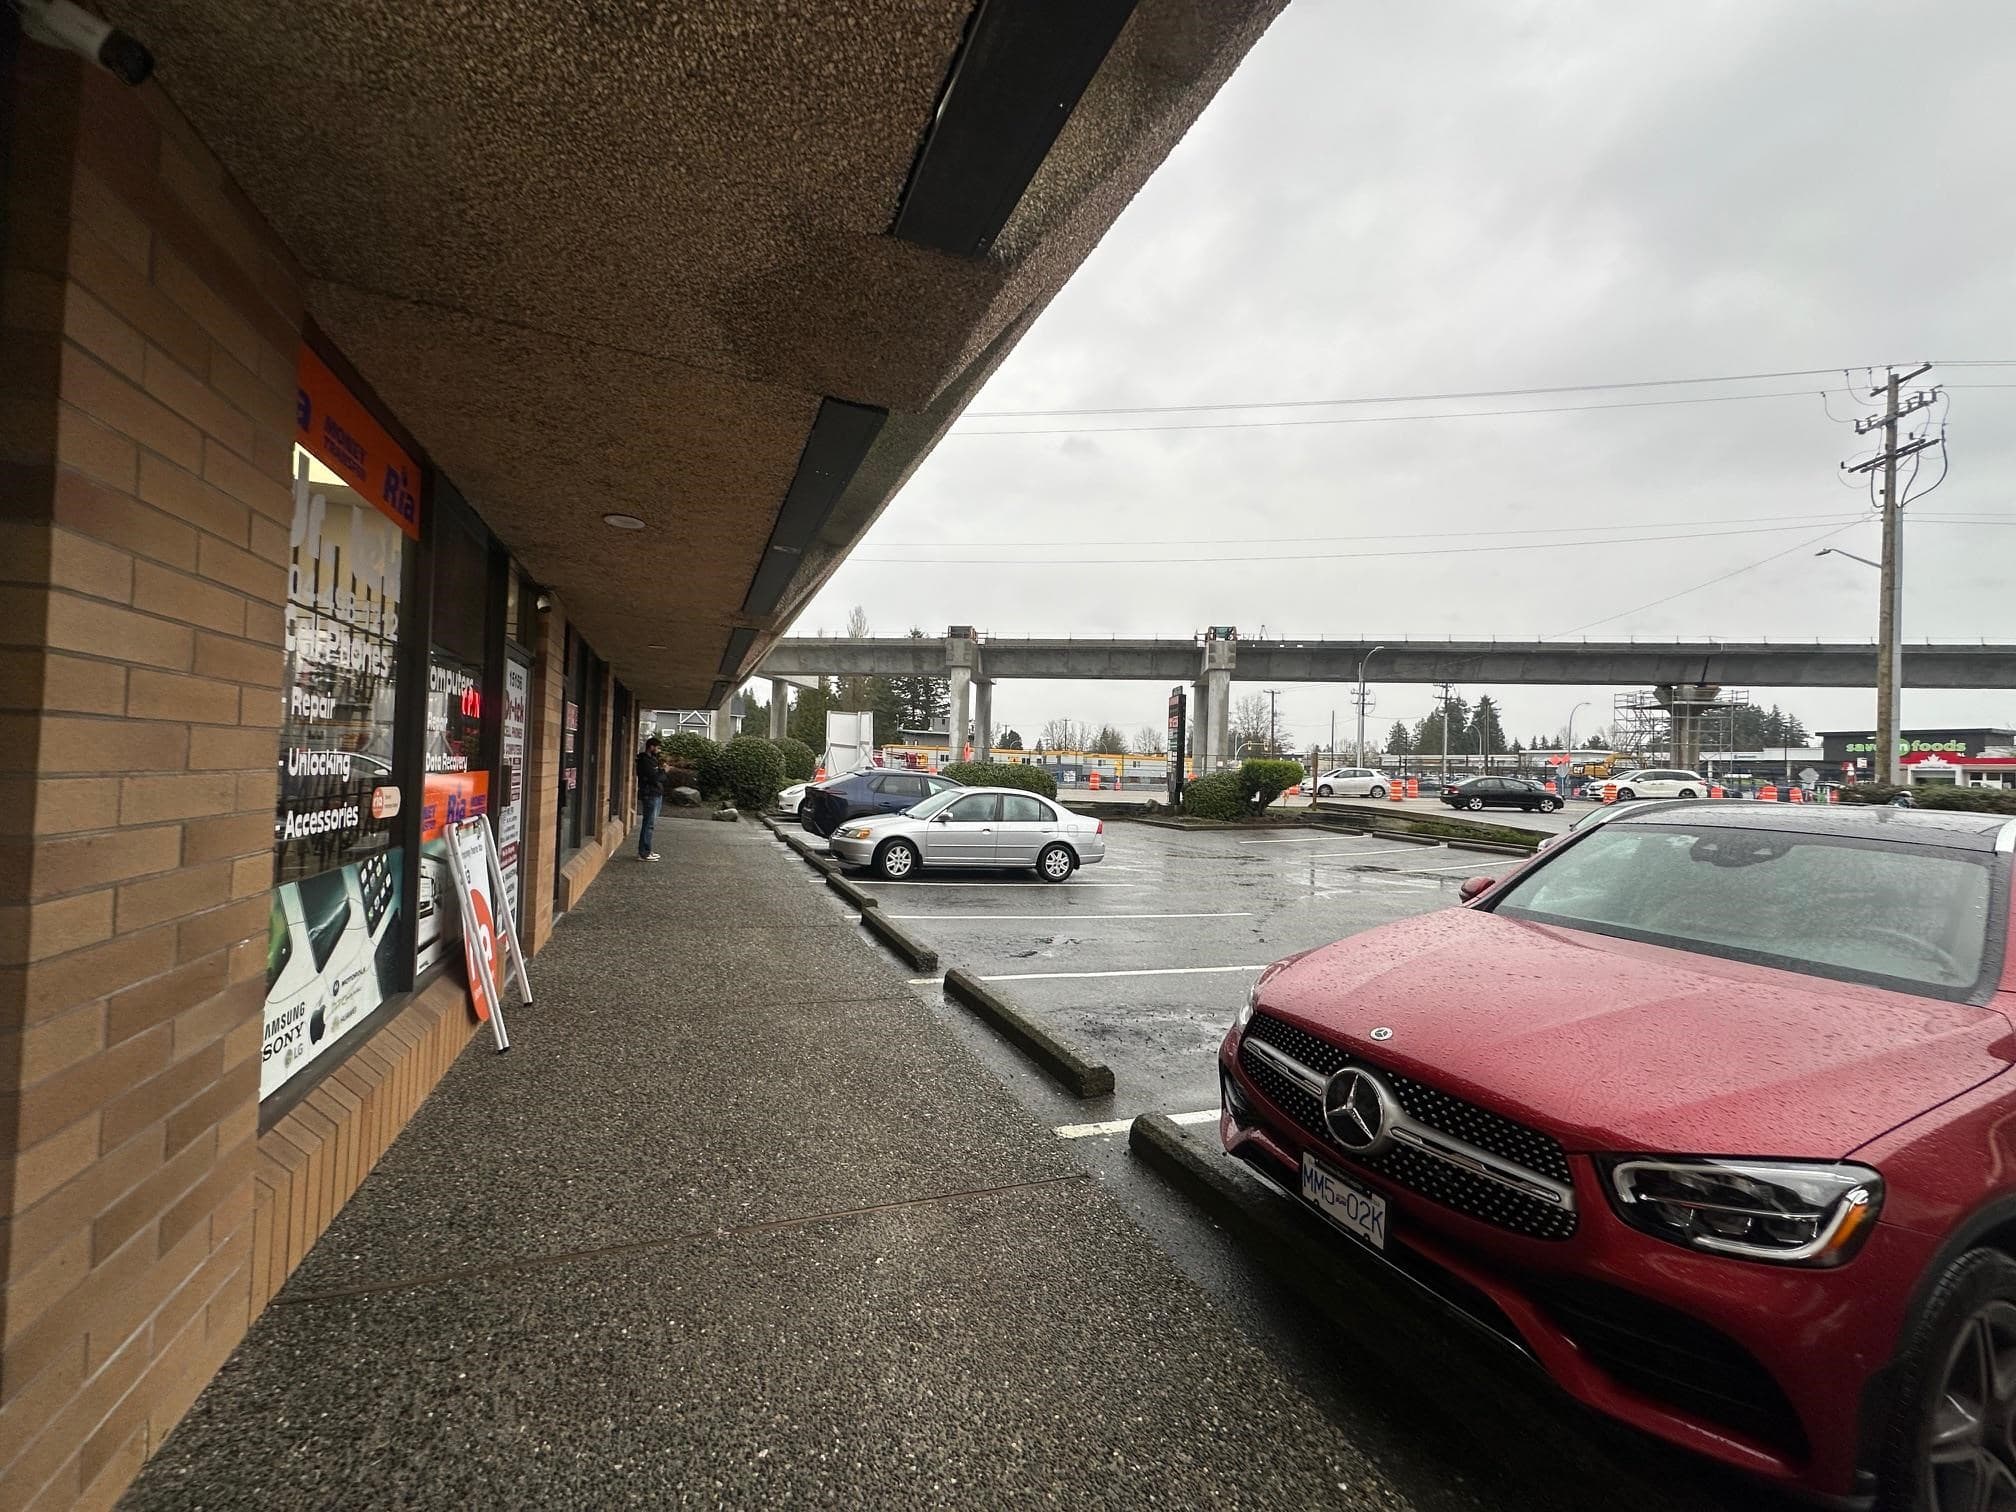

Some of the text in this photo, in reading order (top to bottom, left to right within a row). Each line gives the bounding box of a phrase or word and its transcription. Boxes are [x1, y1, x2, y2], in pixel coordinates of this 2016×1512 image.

[384, 464, 415, 524] Ria
[430, 666, 474, 699] omputers
[291, 686, 336, 724] Repair
[425, 752, 467, 774] Data Recovery
[1846, 743, 1877, 752] sav
[1911, 739, 1966, 752] foods
[288, 748, 350, 782] Unlocking
[284, 802, 358, 840] Accessories
[446, 784, 466, 824] Ria
[264, 1001, 306, 1041] AMSUNG
[262, 1021, 304, 1063] SONY
[293, 1042, 304, 1059] LG
